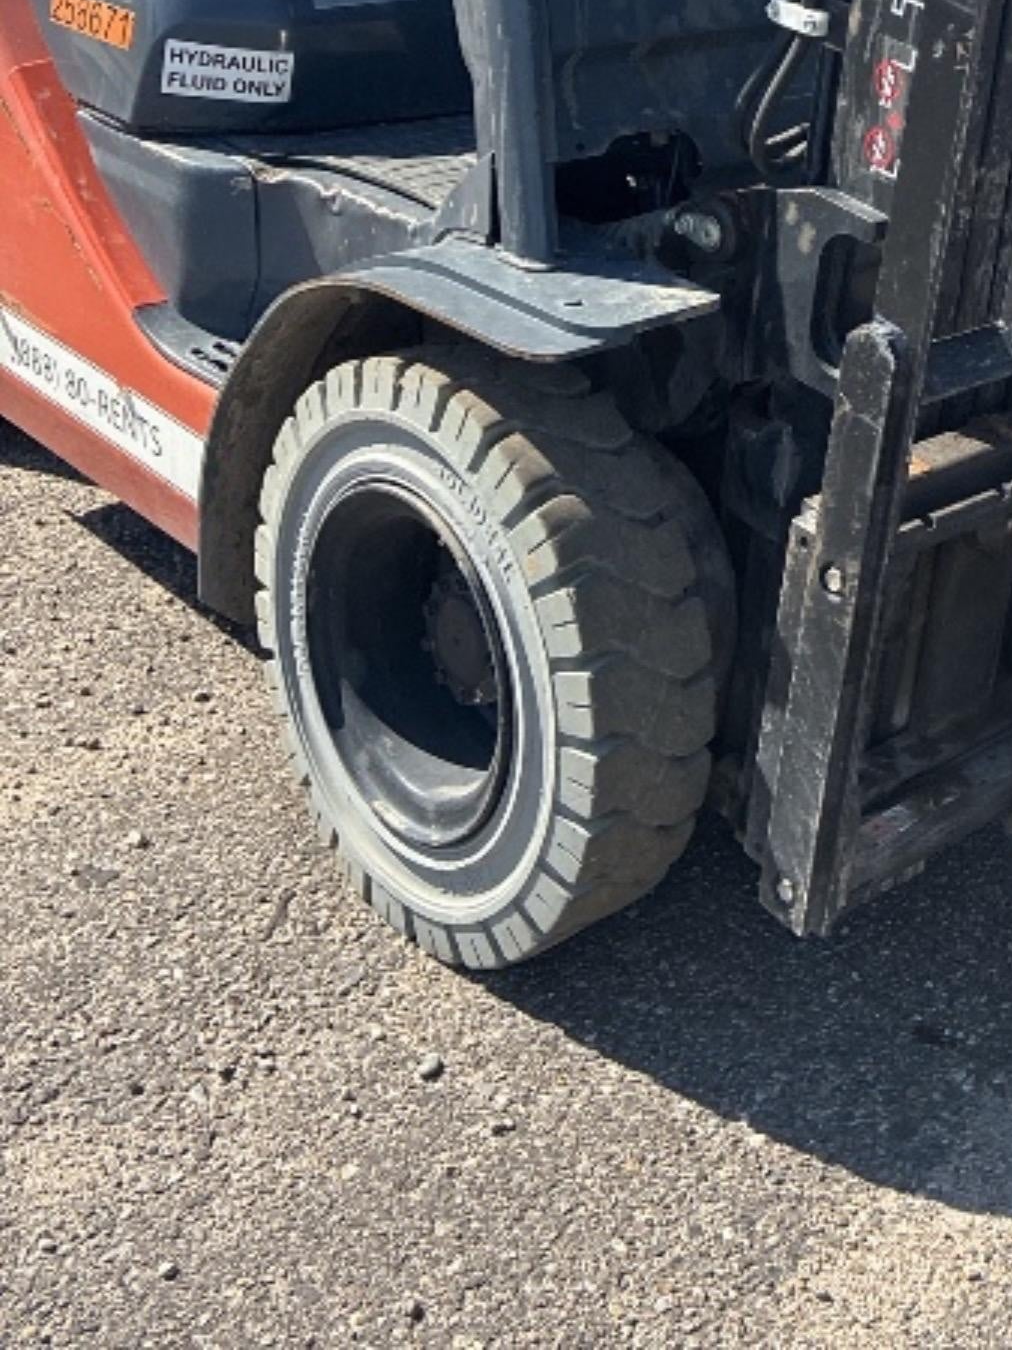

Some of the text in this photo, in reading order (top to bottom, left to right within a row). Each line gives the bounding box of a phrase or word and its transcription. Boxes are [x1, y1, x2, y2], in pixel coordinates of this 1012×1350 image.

[169, 47, 289, 75] HYDRAULIC
[166, 71, 287, 97] FLUID ONLY
